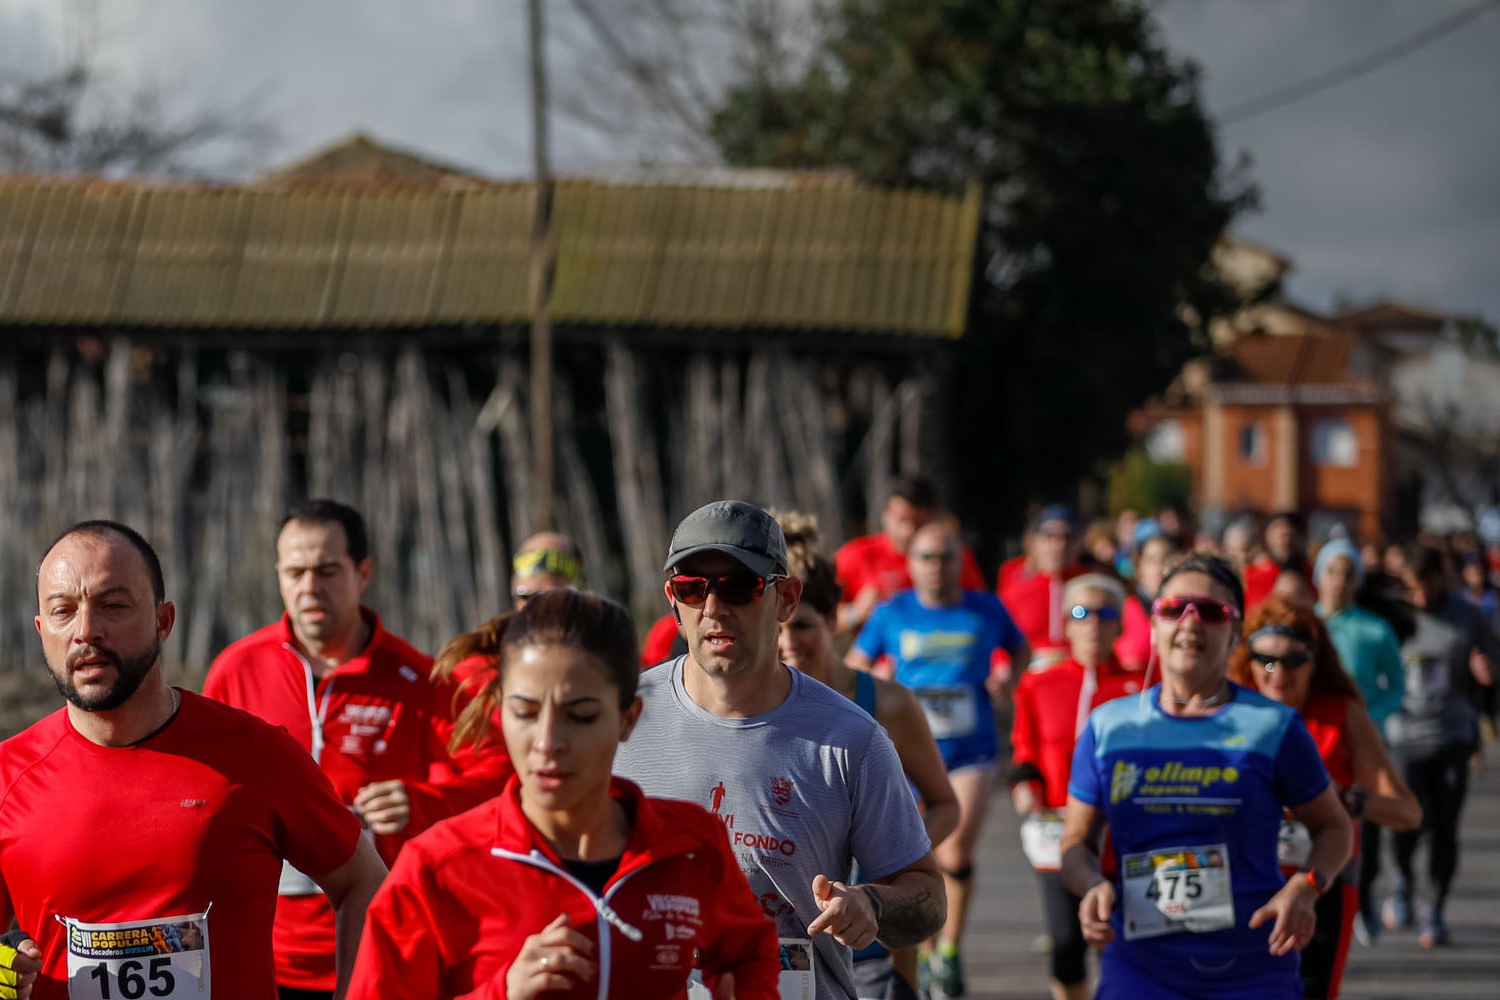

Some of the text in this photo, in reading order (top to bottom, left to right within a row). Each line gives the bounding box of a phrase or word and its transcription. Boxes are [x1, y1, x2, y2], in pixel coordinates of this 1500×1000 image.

[1145, 761, 1239, 788] olimpo
[734, 832, 795, 856] FONDO
[1145, 874, 1203, 900] 475
[91, 929, 149, 940] CARRERA
[92, 938, 149, 948] POPULAR
[90, 948, 124, 956] Secaderos
[91, 957, 175, 1000] 165
